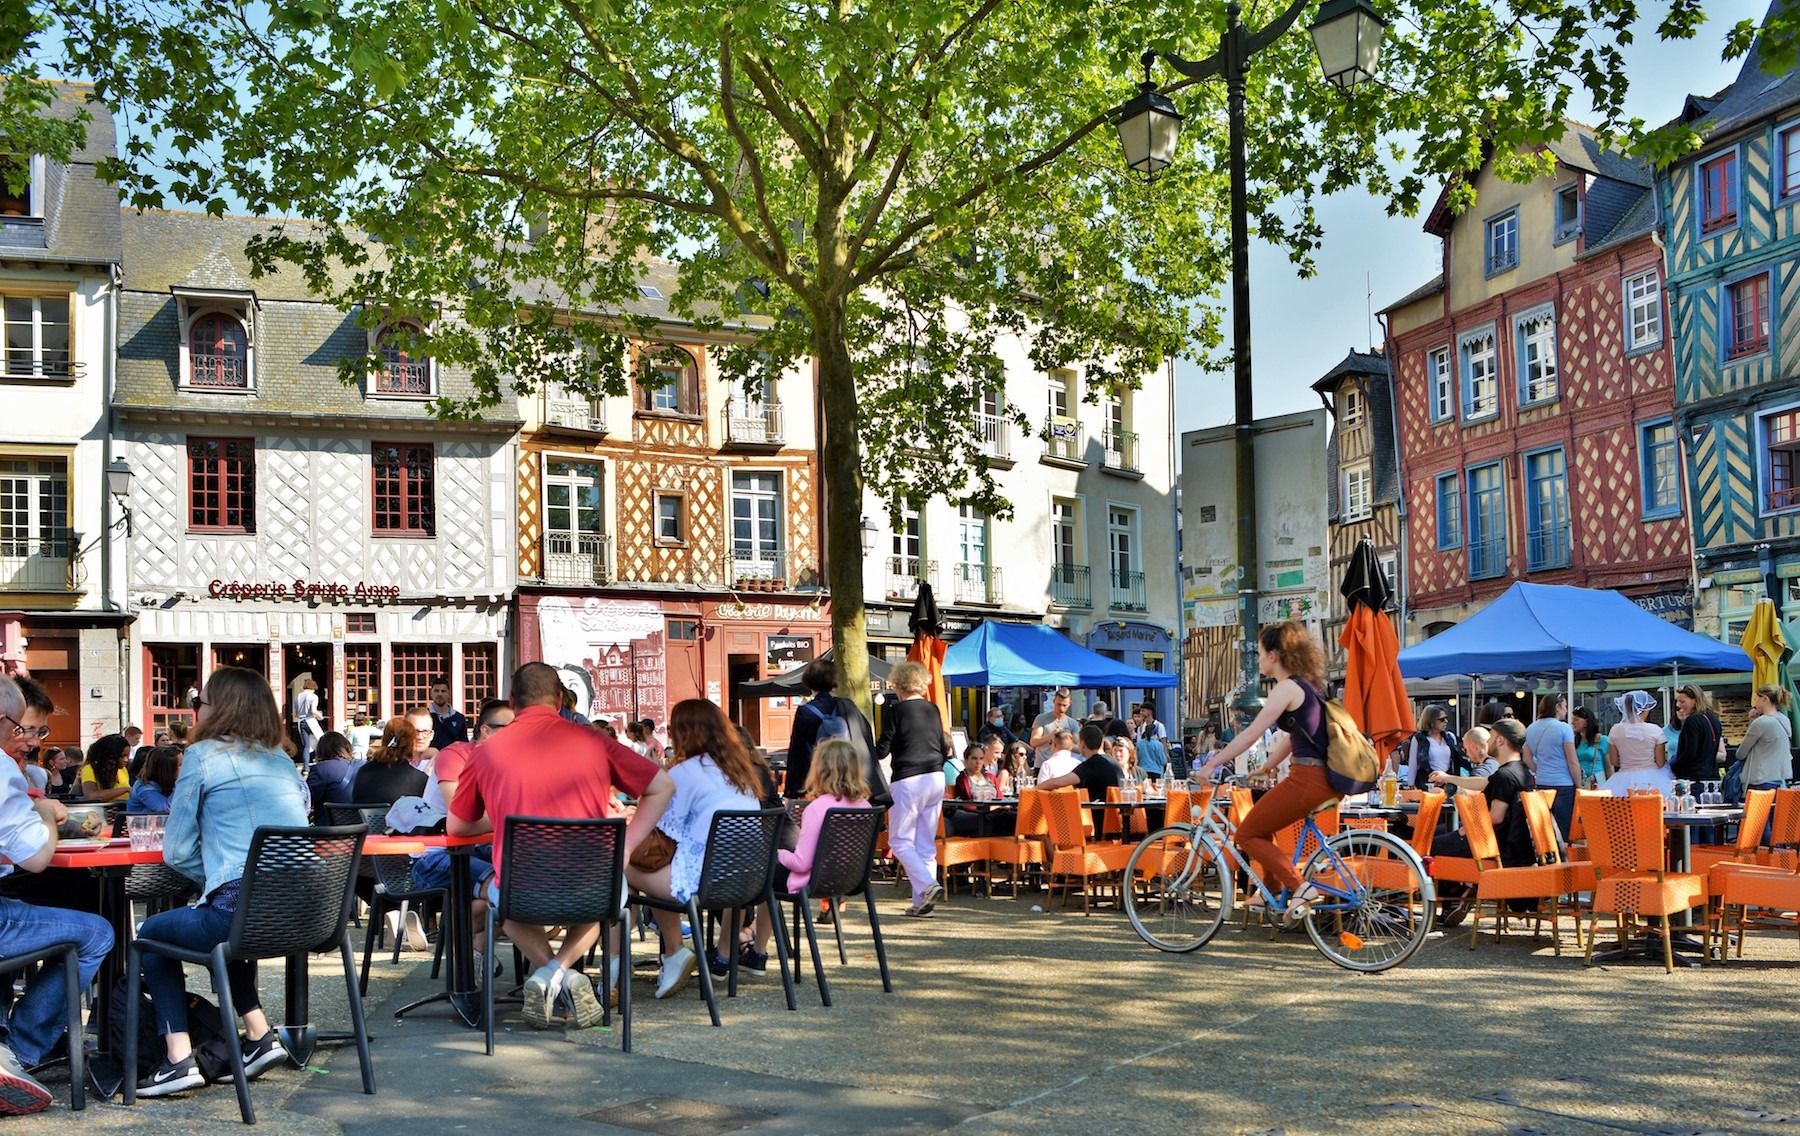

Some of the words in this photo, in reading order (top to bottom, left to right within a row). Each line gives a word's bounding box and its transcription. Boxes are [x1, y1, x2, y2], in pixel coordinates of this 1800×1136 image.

[209, 579, 287, 599] Crêperie
[294, 579, 348, 597] Sainte
[355, 581, 400, 597] Anne
[868, 617, 881, 625] Bar
[796, 640, 810, 649] BIO
[786, 650, 794, 658] et
